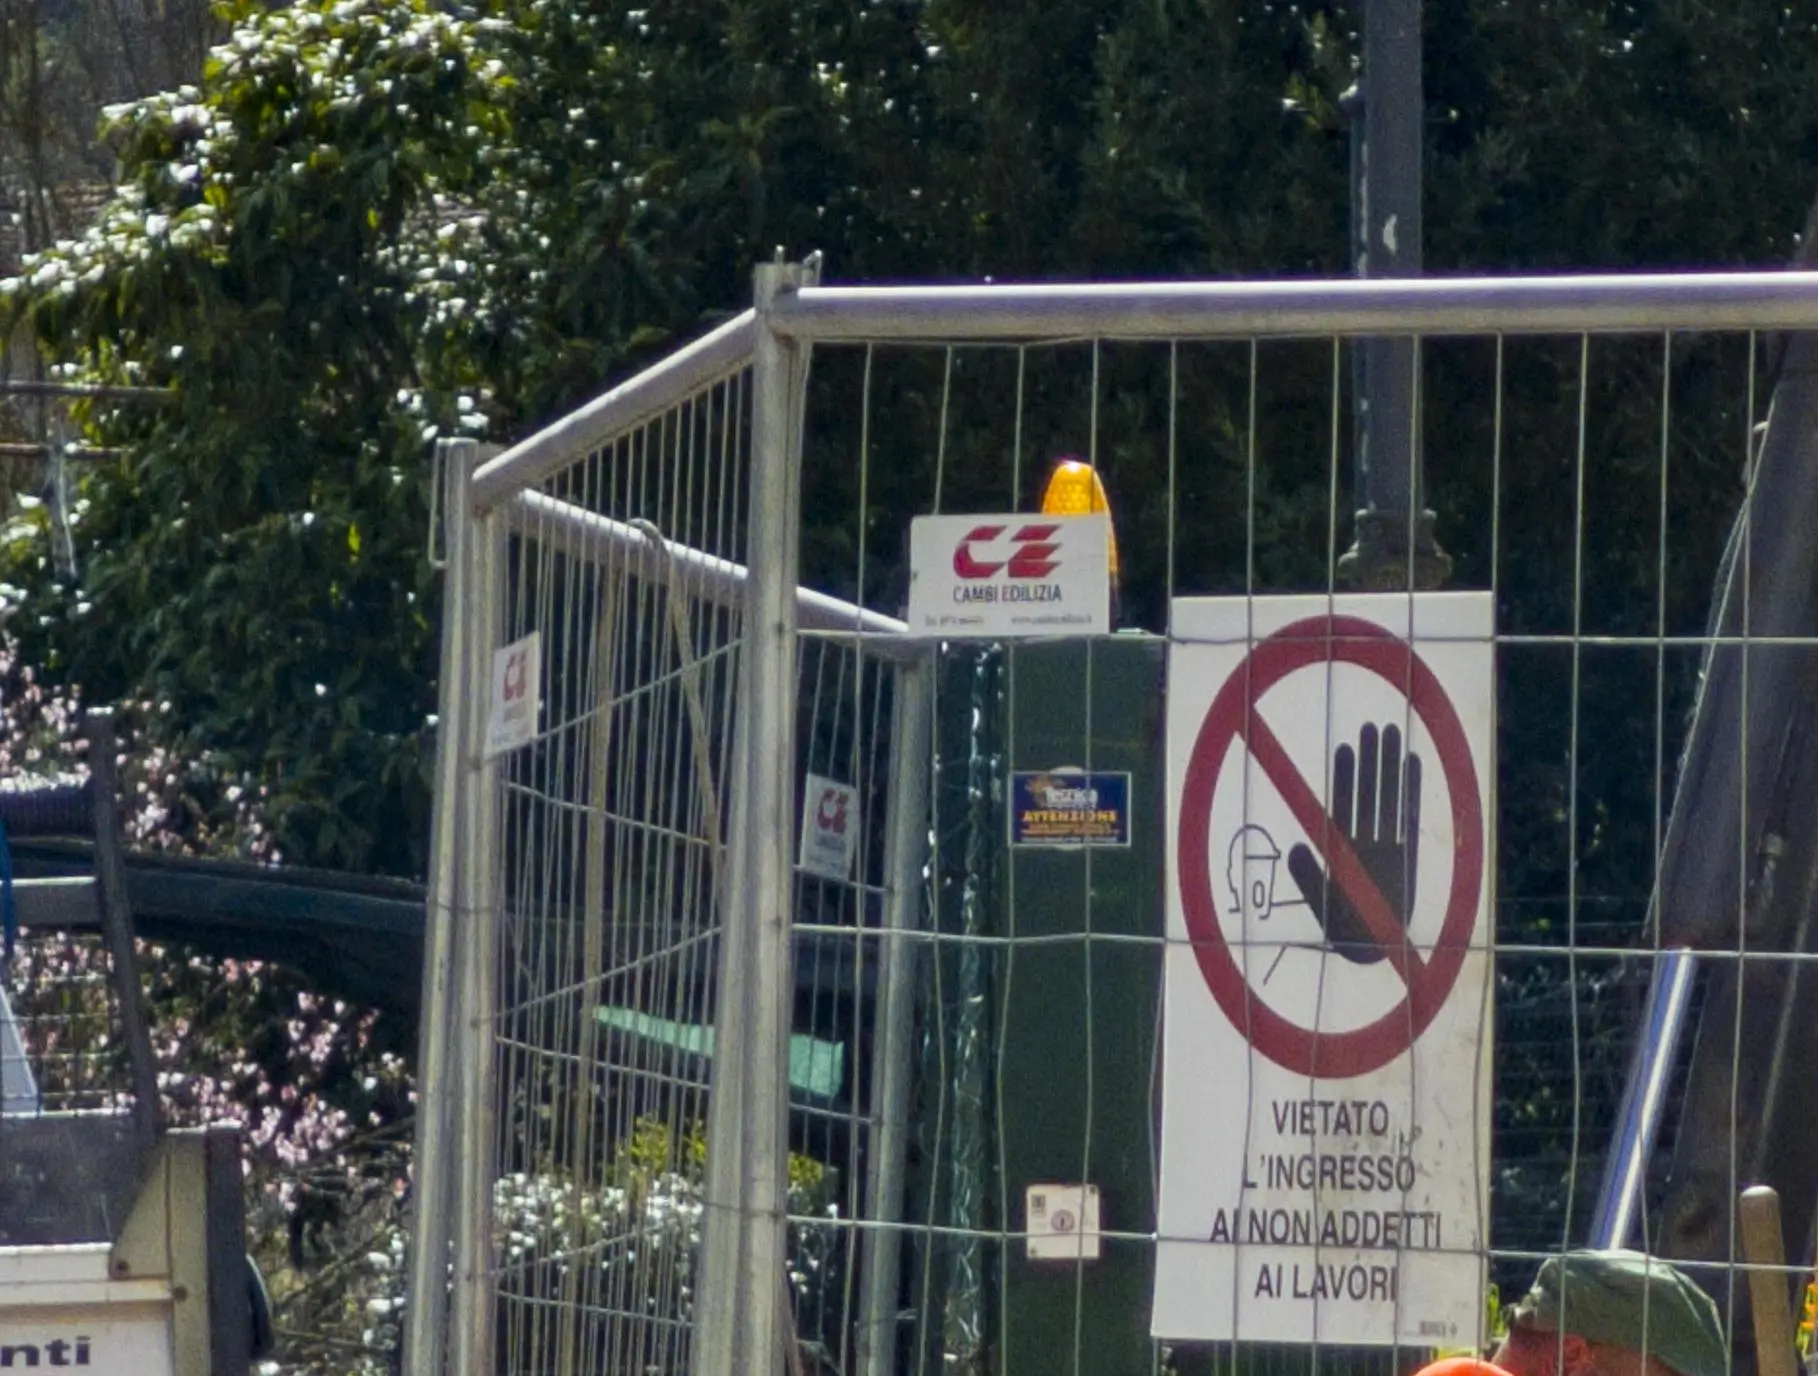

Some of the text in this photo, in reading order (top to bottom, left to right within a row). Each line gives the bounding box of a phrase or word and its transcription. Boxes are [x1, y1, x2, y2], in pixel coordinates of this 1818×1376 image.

[953, 524, 1063, 579] CE
[952, 583, 1063, 604] CAMBI EDILIZIA
[1272, 1099, 1390, 1137] VIETATO
[1242, 1154, 1416, 1192] L'INGRESSO
[1209, 1207, 1442, 1250] AI NON ADDETTI
[1254, 1263, 1399, 1302] AI LAVORI
[0, 1336, 92, 1367] nti
